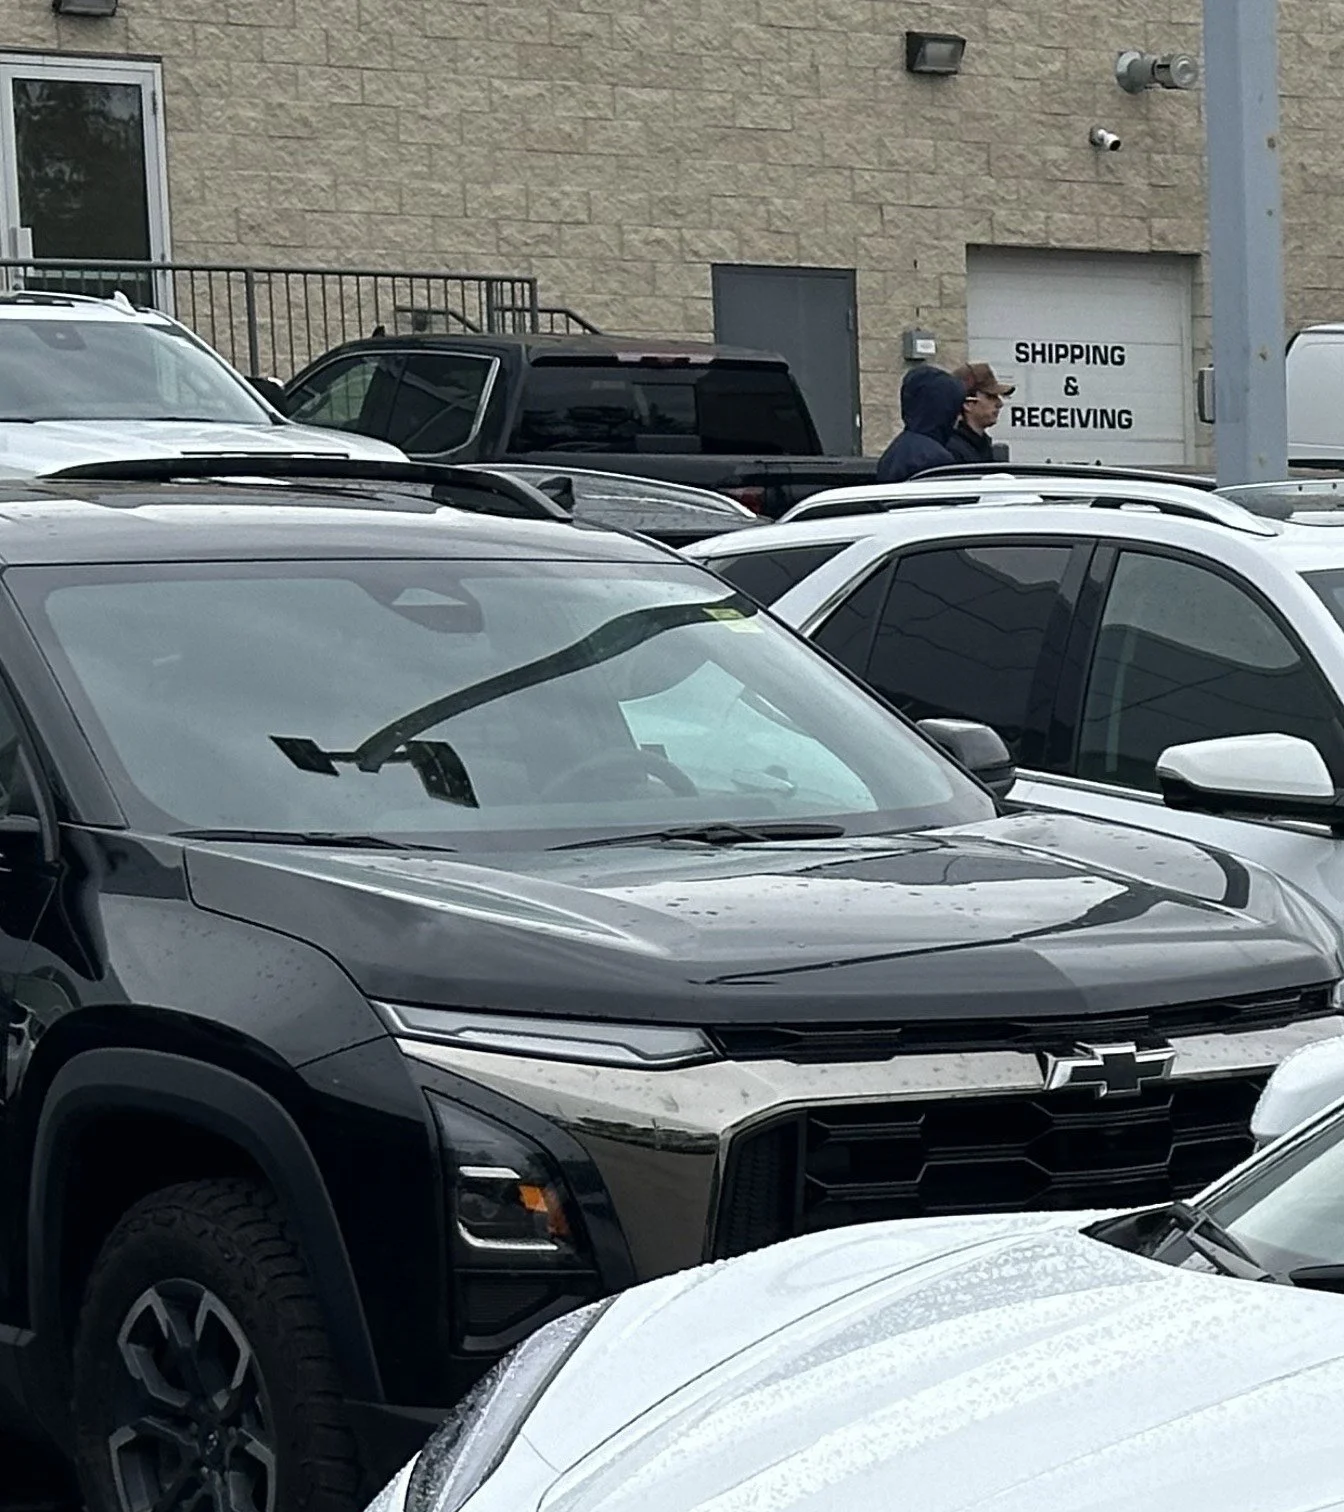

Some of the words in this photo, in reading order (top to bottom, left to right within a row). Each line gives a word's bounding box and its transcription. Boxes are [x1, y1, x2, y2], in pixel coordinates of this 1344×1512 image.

[1015, 342, 1125, 366] SHIPPING
[1064, 376, 1079, 397] &
[1011, 406, 1133, 430] RECEIVING
